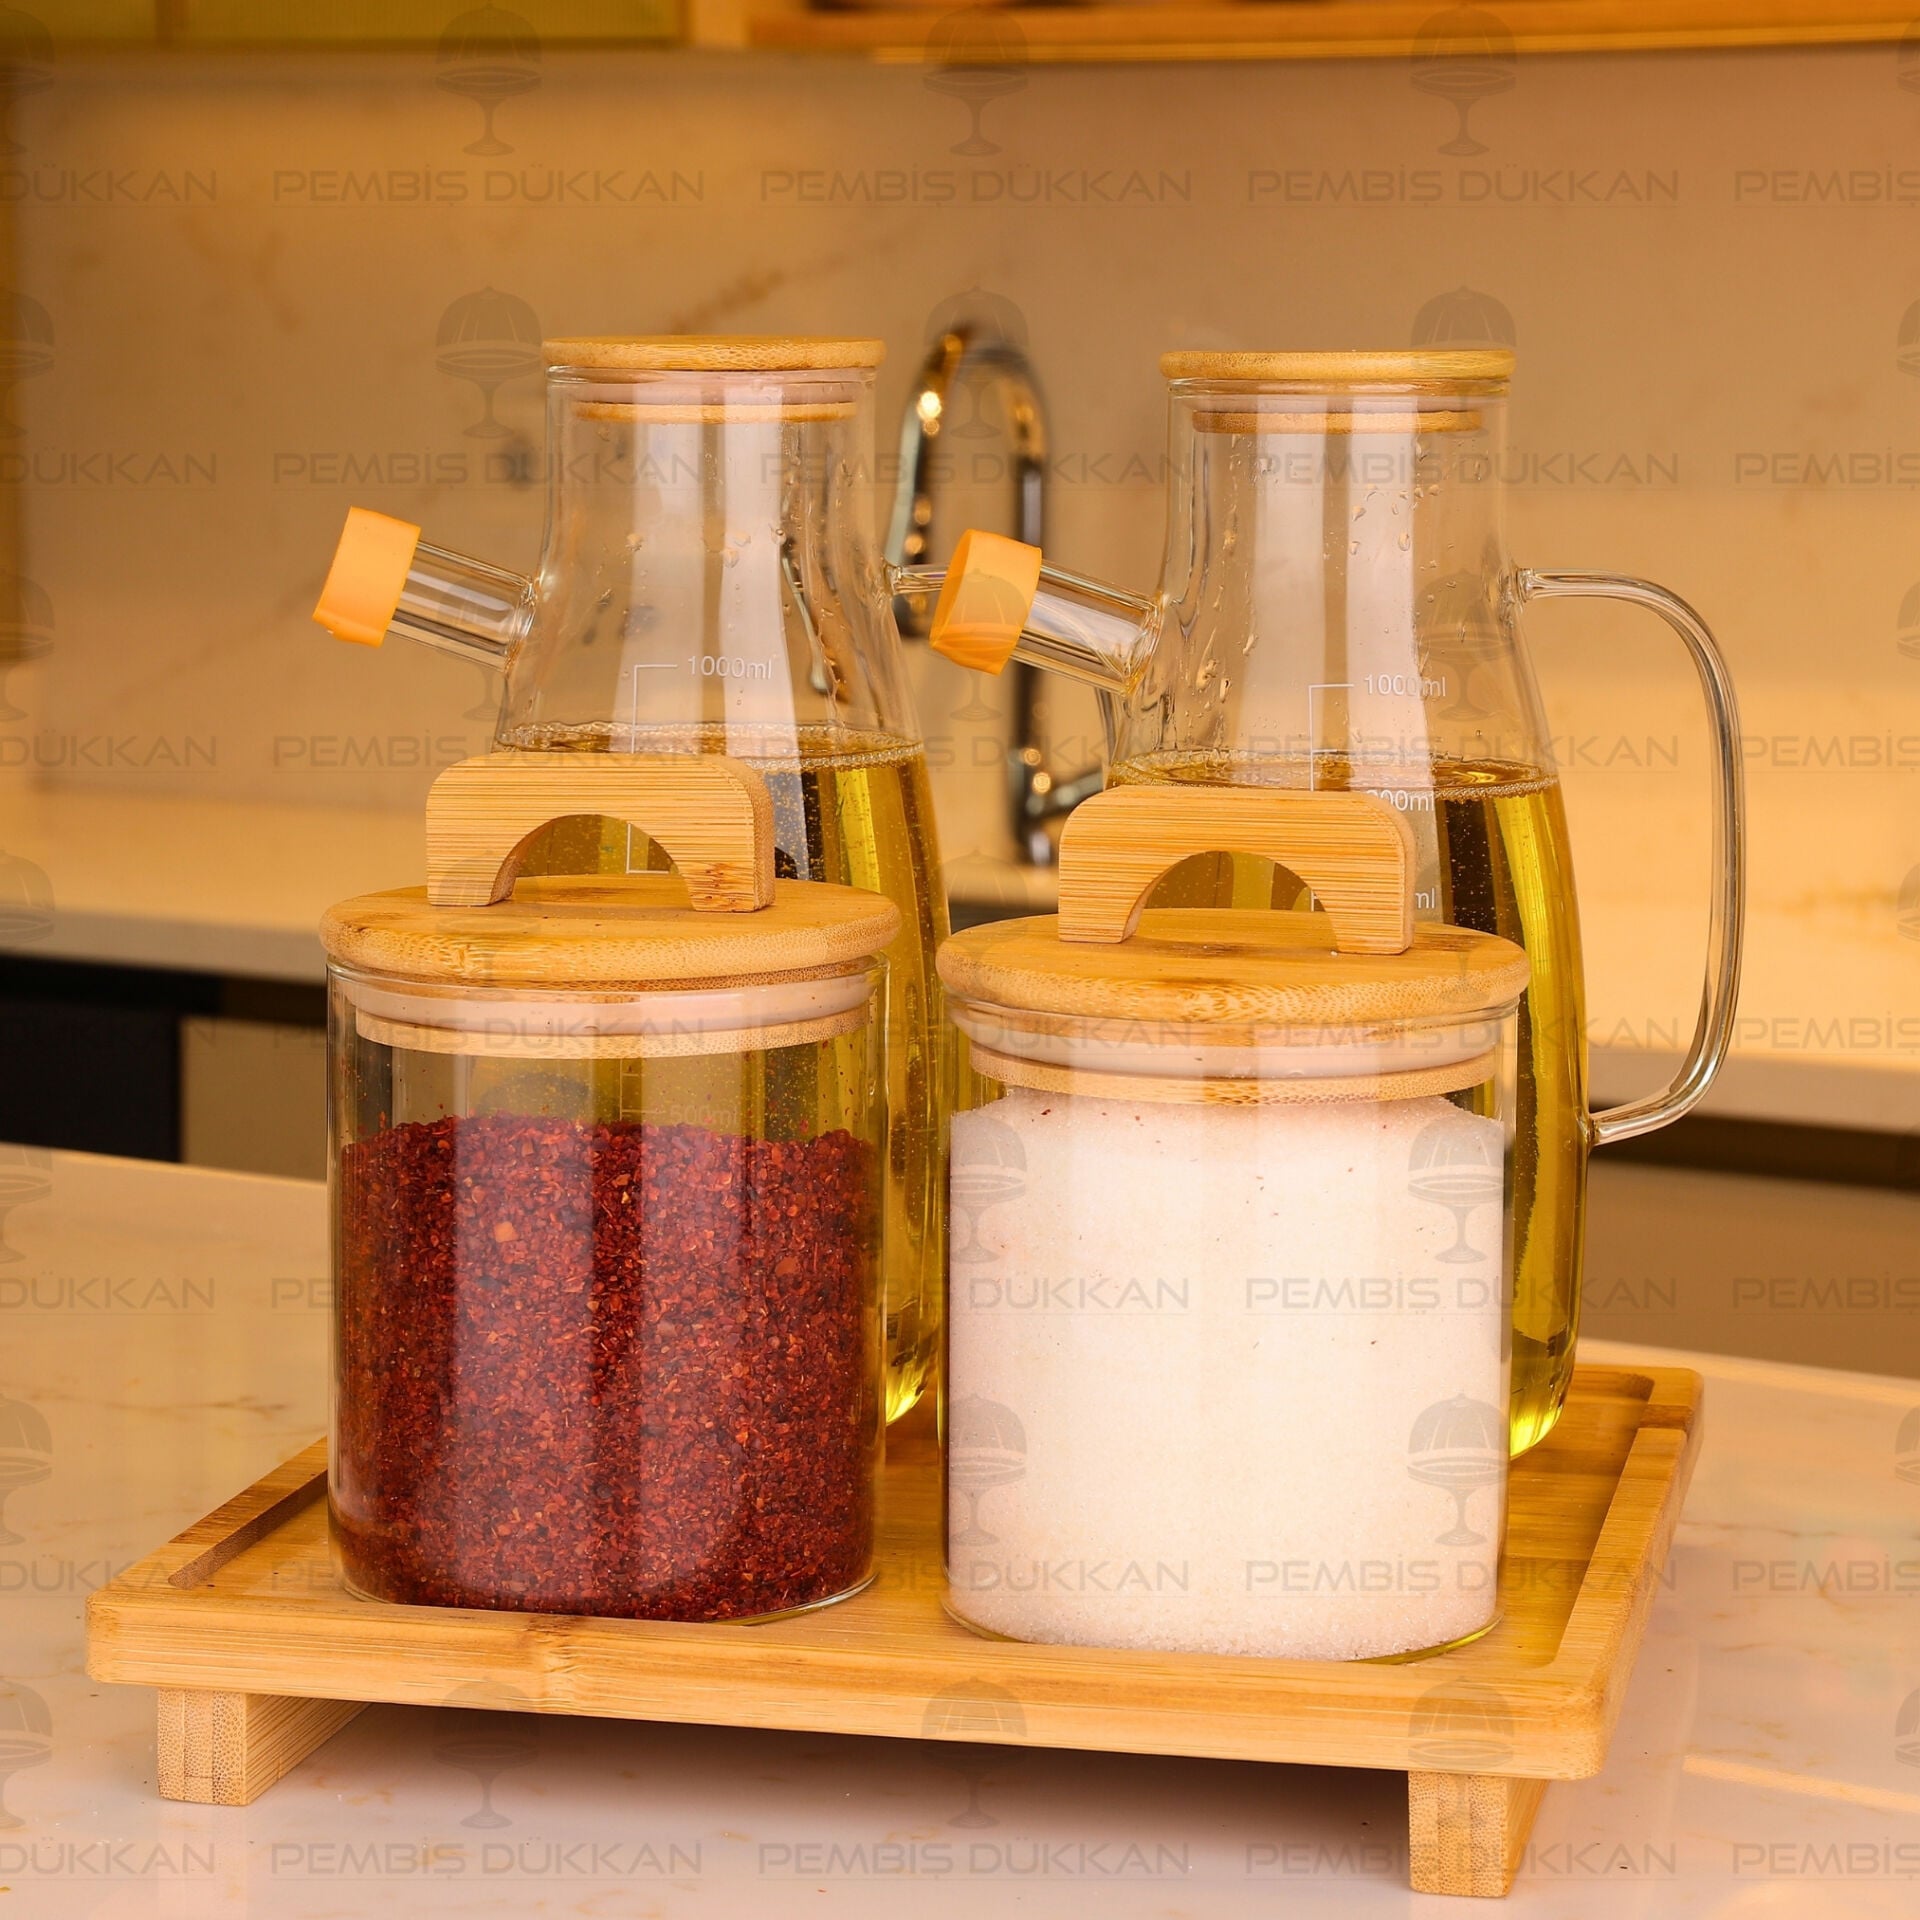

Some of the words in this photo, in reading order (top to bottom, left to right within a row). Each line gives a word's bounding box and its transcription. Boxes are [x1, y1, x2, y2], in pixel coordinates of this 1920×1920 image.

[688, 655, 772, 680] 1000ml
[1364, 674, 1446, 697] 1000ml
[1366, 789, 1435, 812] 00ml
